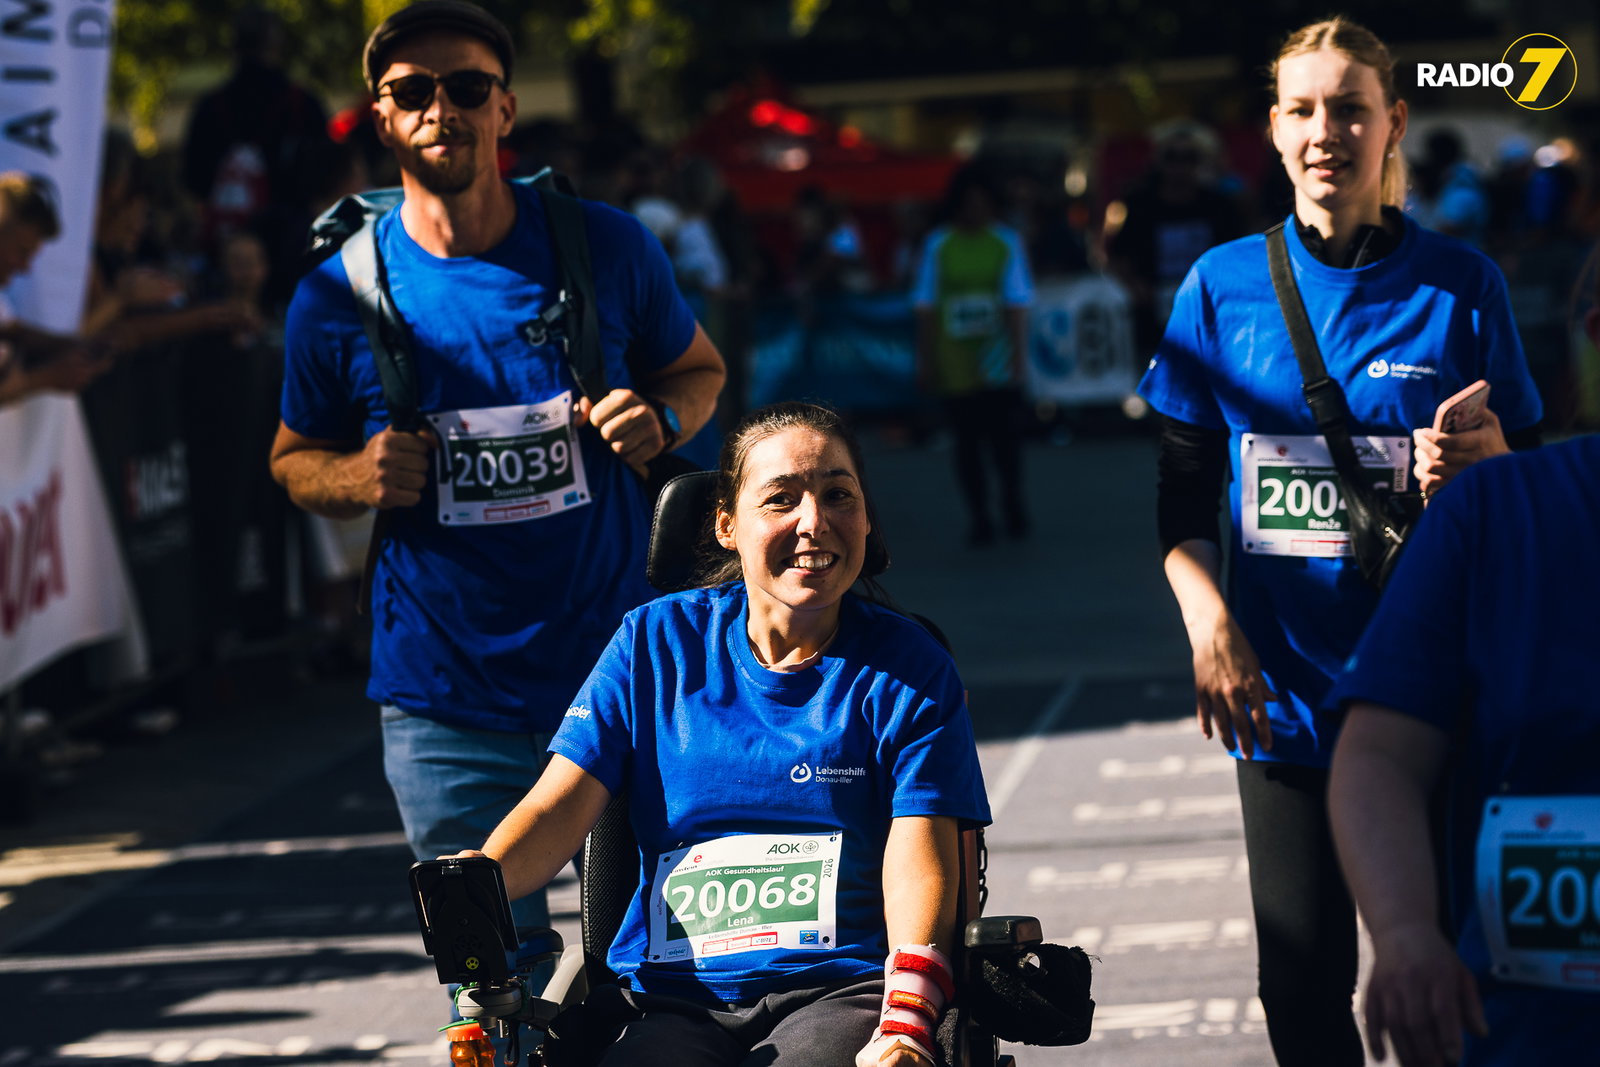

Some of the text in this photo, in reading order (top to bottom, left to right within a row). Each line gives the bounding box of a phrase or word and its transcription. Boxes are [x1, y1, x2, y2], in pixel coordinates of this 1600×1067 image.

[522, 410, 550, 426] AOK
[454, 439, 569, 489] 20039
[766, 843, 801, 855] AOK
[705, 868, 722, 877] AOK
[724, 865, 785, 876] Gesundheitslauf
[823, 858, 834, 879] 2026
[670, 873, 817, 924] 20068
[727, 915, 754, 928] Lena
